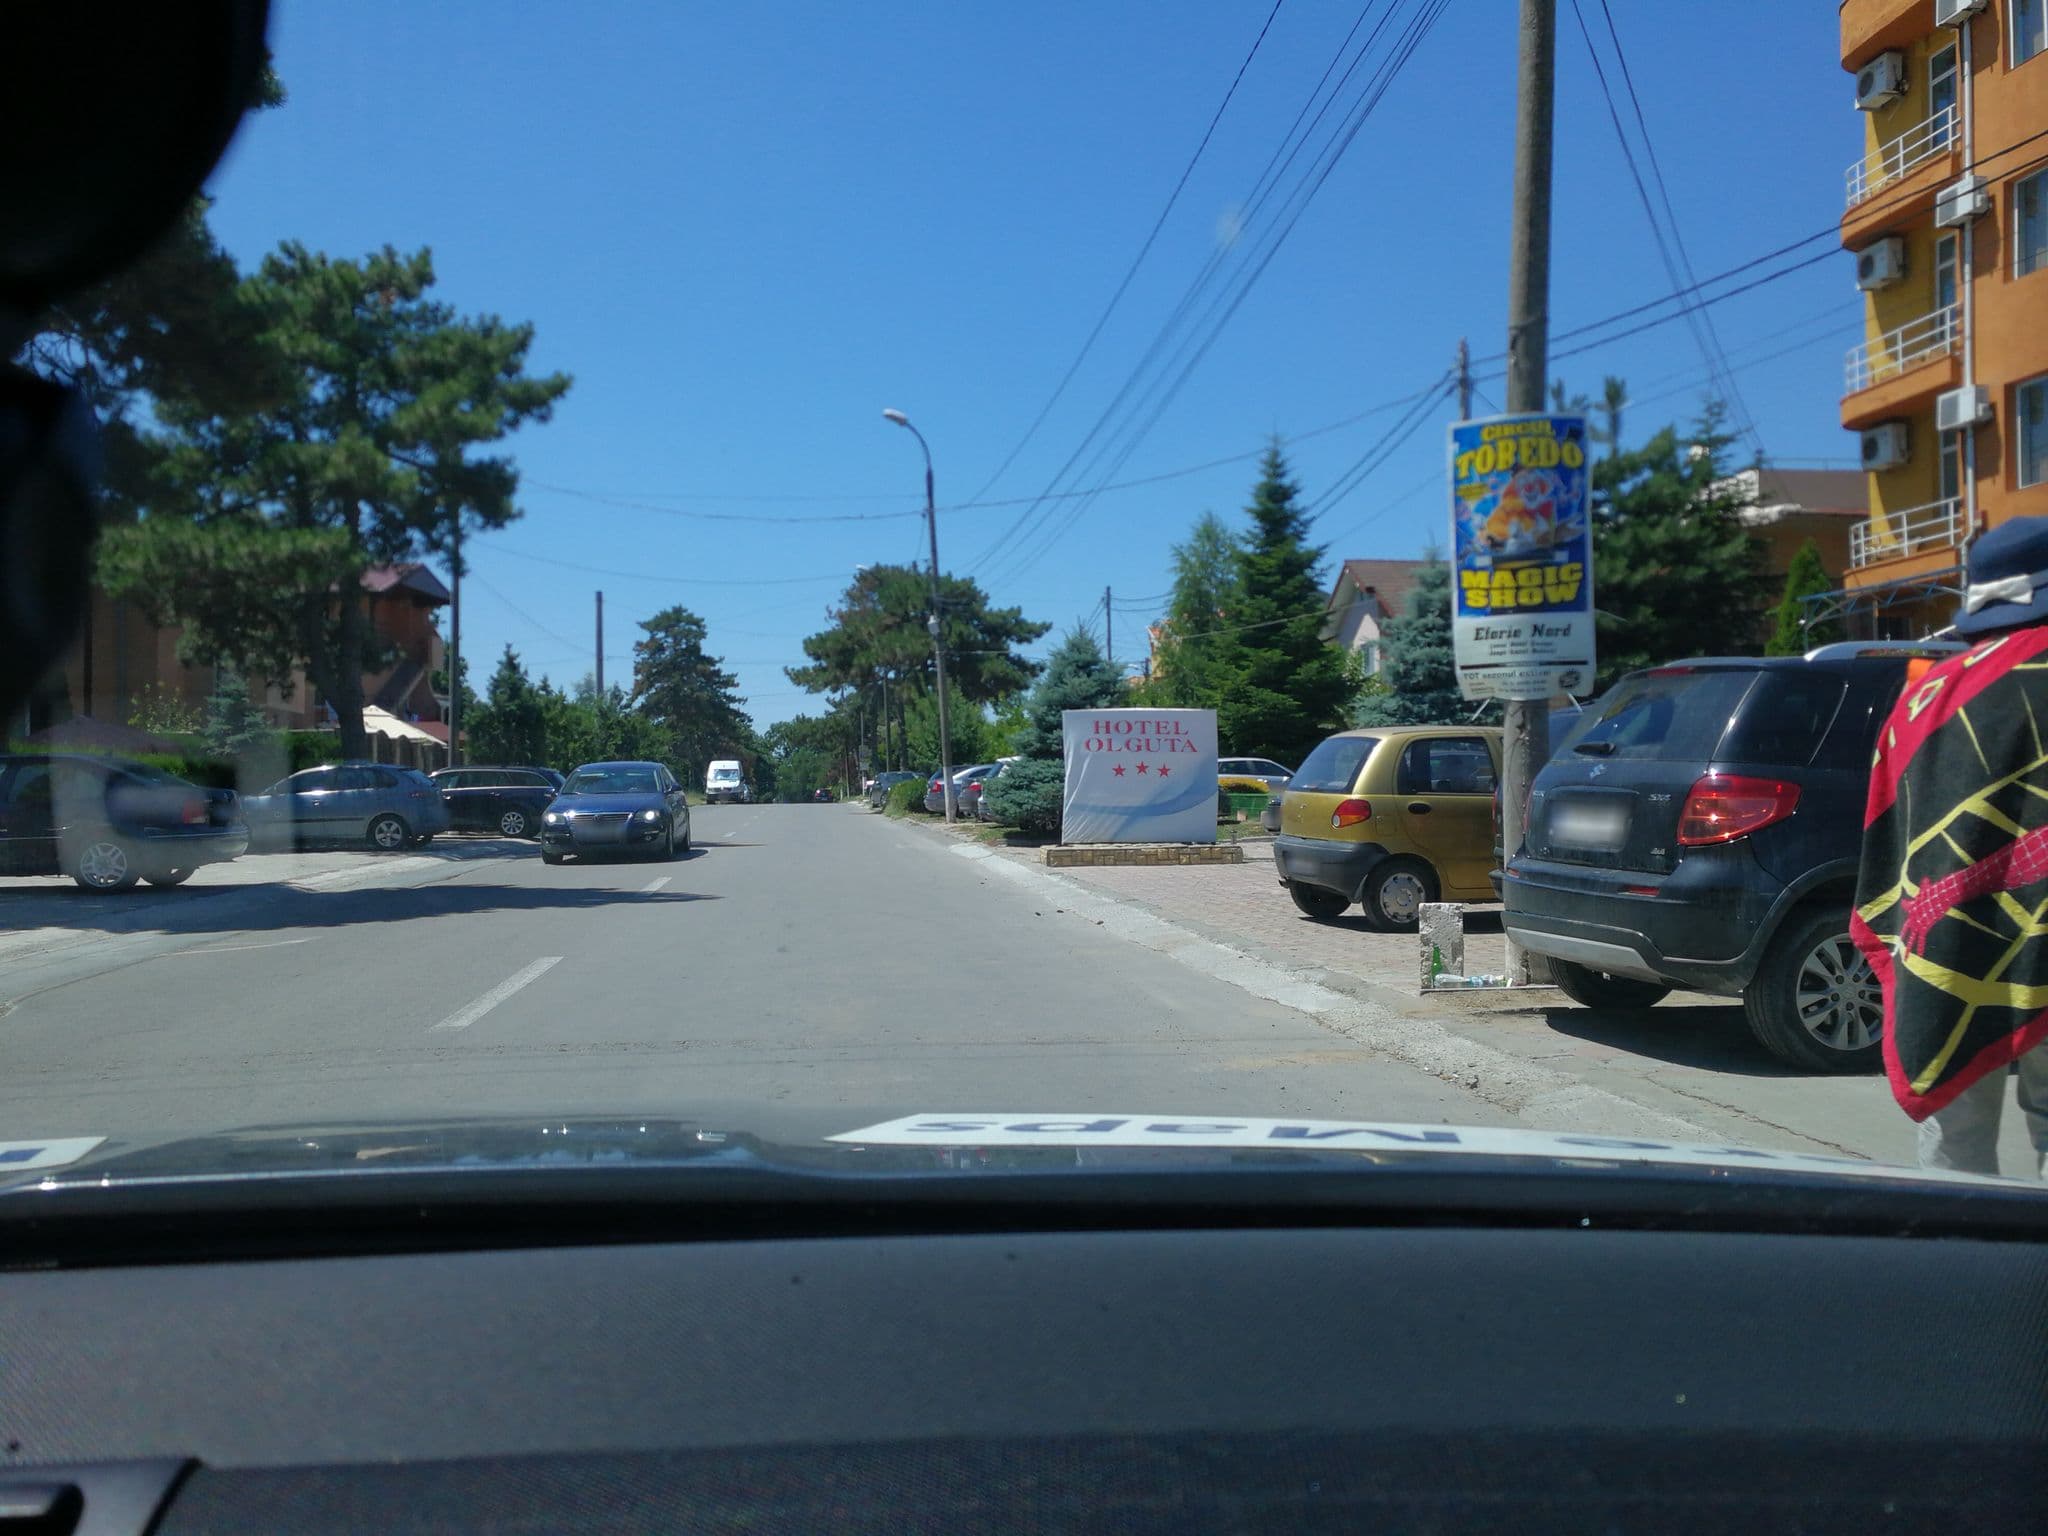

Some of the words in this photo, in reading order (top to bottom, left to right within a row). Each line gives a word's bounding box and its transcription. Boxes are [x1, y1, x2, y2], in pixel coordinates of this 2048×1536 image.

[1461, 562, 1583, 588] MAGIC
[1465, 582, 1580, 608] SHOW
[1531, 623, 1571, 638] Nord
[1093, 720, 1189, 735] HOTEL
[1084, 737, 1198, 752] OLGUTA
